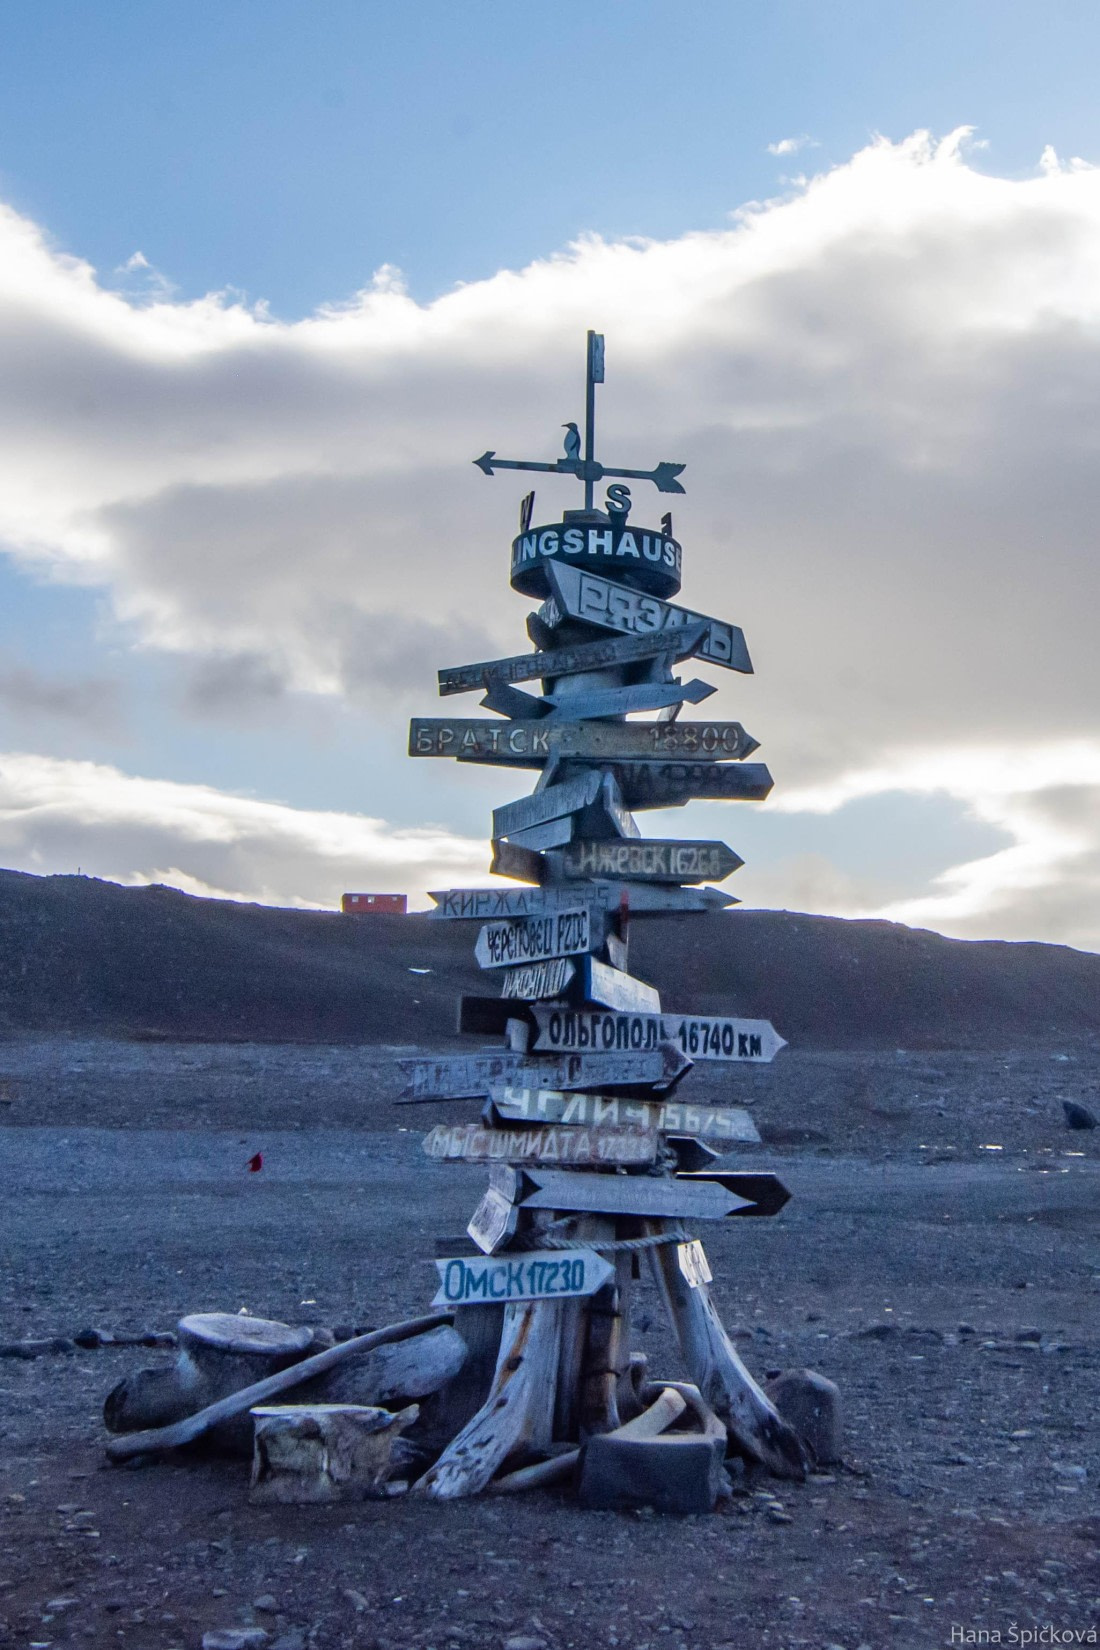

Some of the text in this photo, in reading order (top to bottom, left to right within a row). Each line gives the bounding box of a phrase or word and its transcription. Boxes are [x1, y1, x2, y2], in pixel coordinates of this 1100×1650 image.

[416, 726, 741, 754] БРАТСК 18800
[678, 1020, 734, 1055] 16740
[488, 1129, 590, 1161] ШМИДТА
[526, 1259, 585, 1296] 17230
